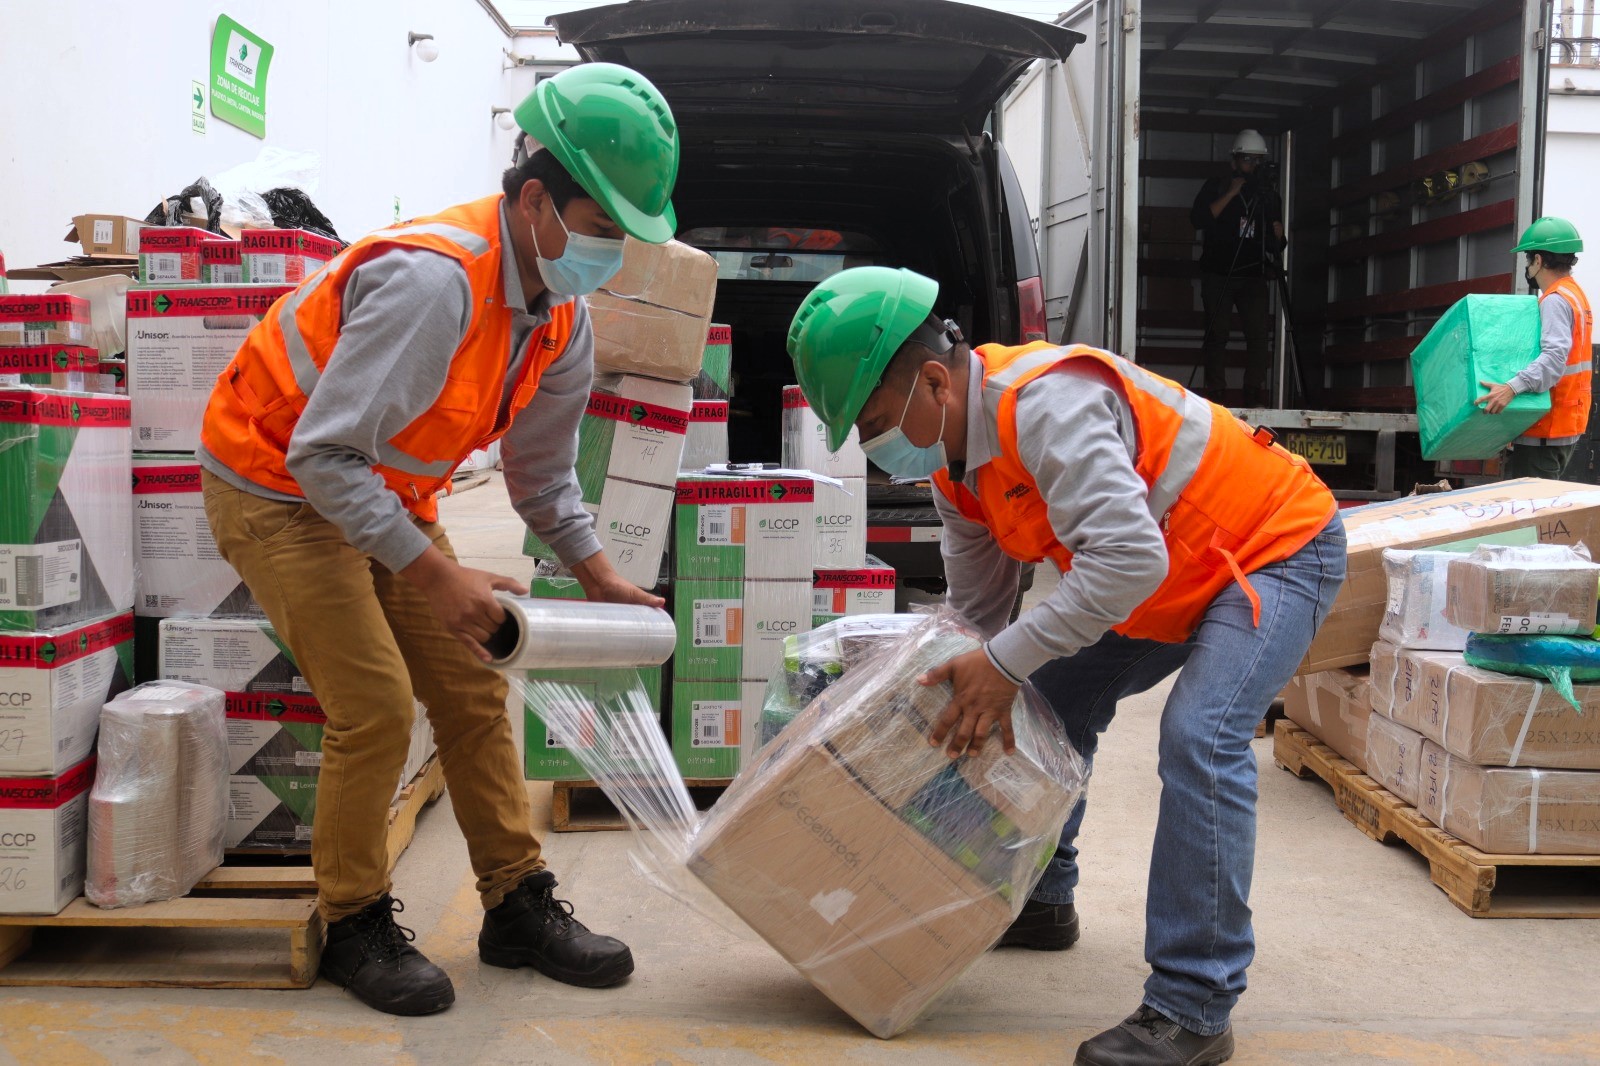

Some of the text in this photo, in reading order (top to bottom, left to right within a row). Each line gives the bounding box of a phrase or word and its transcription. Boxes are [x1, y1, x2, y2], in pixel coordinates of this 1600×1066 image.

[229, 57, 254, 76] TRANSCORP
[217, 74, 260, 108] ZONA DE RECICLAJE
[175, 297, 232, 307] TRANSCORP
[1289, 440, 1344, 460] BAC-710
[143, 473, 201, 485] TRANSCORP
[710, 485, 752, 500] FRAGIL
[768, 518, 800, 531] LCCP
[824, 515, 852, 526] LCCP
[619, 523, 651, 540] LCCP
[822, 574, 868, 583] TRANSCORP
[766, 620, 797, 633] LCCP
